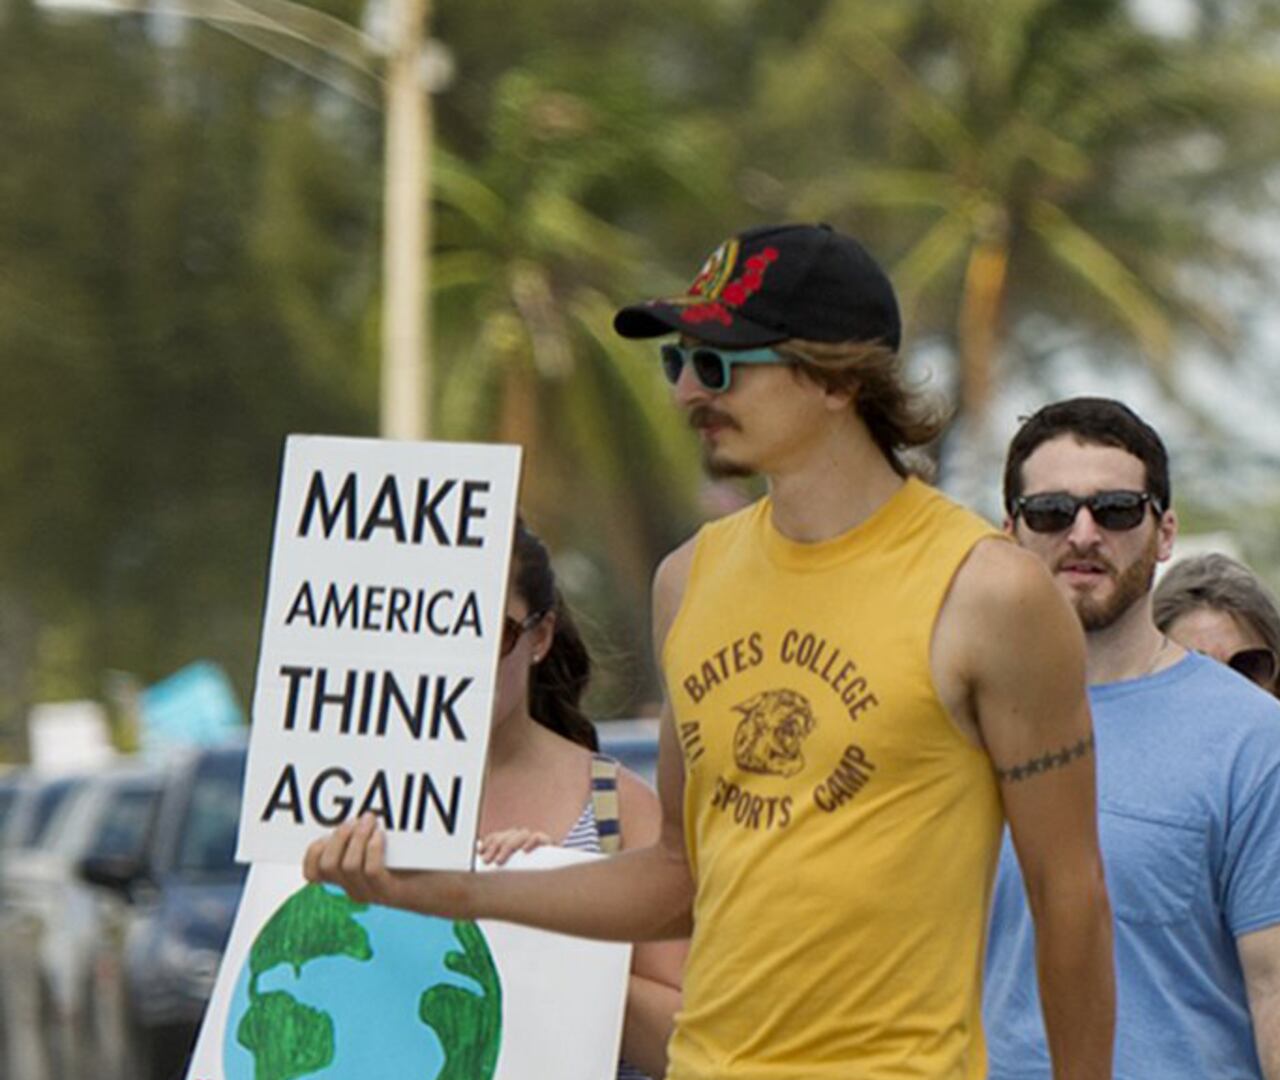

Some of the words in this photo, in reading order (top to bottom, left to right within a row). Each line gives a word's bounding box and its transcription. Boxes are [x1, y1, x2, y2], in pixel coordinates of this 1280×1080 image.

[296, 469, 491, 549] MAKE
[284, 580, 483, 637] AMERICA
[279, 664, 475, 742] THINK
[682, 631, 764, 705] BATES
[779, 629, 880, 722] COLLEGE
[260, 763, 463, 836] AGAIN
[710, 775, 793, 831] SPORTS
[812, 743, 877, 814] CAMP
